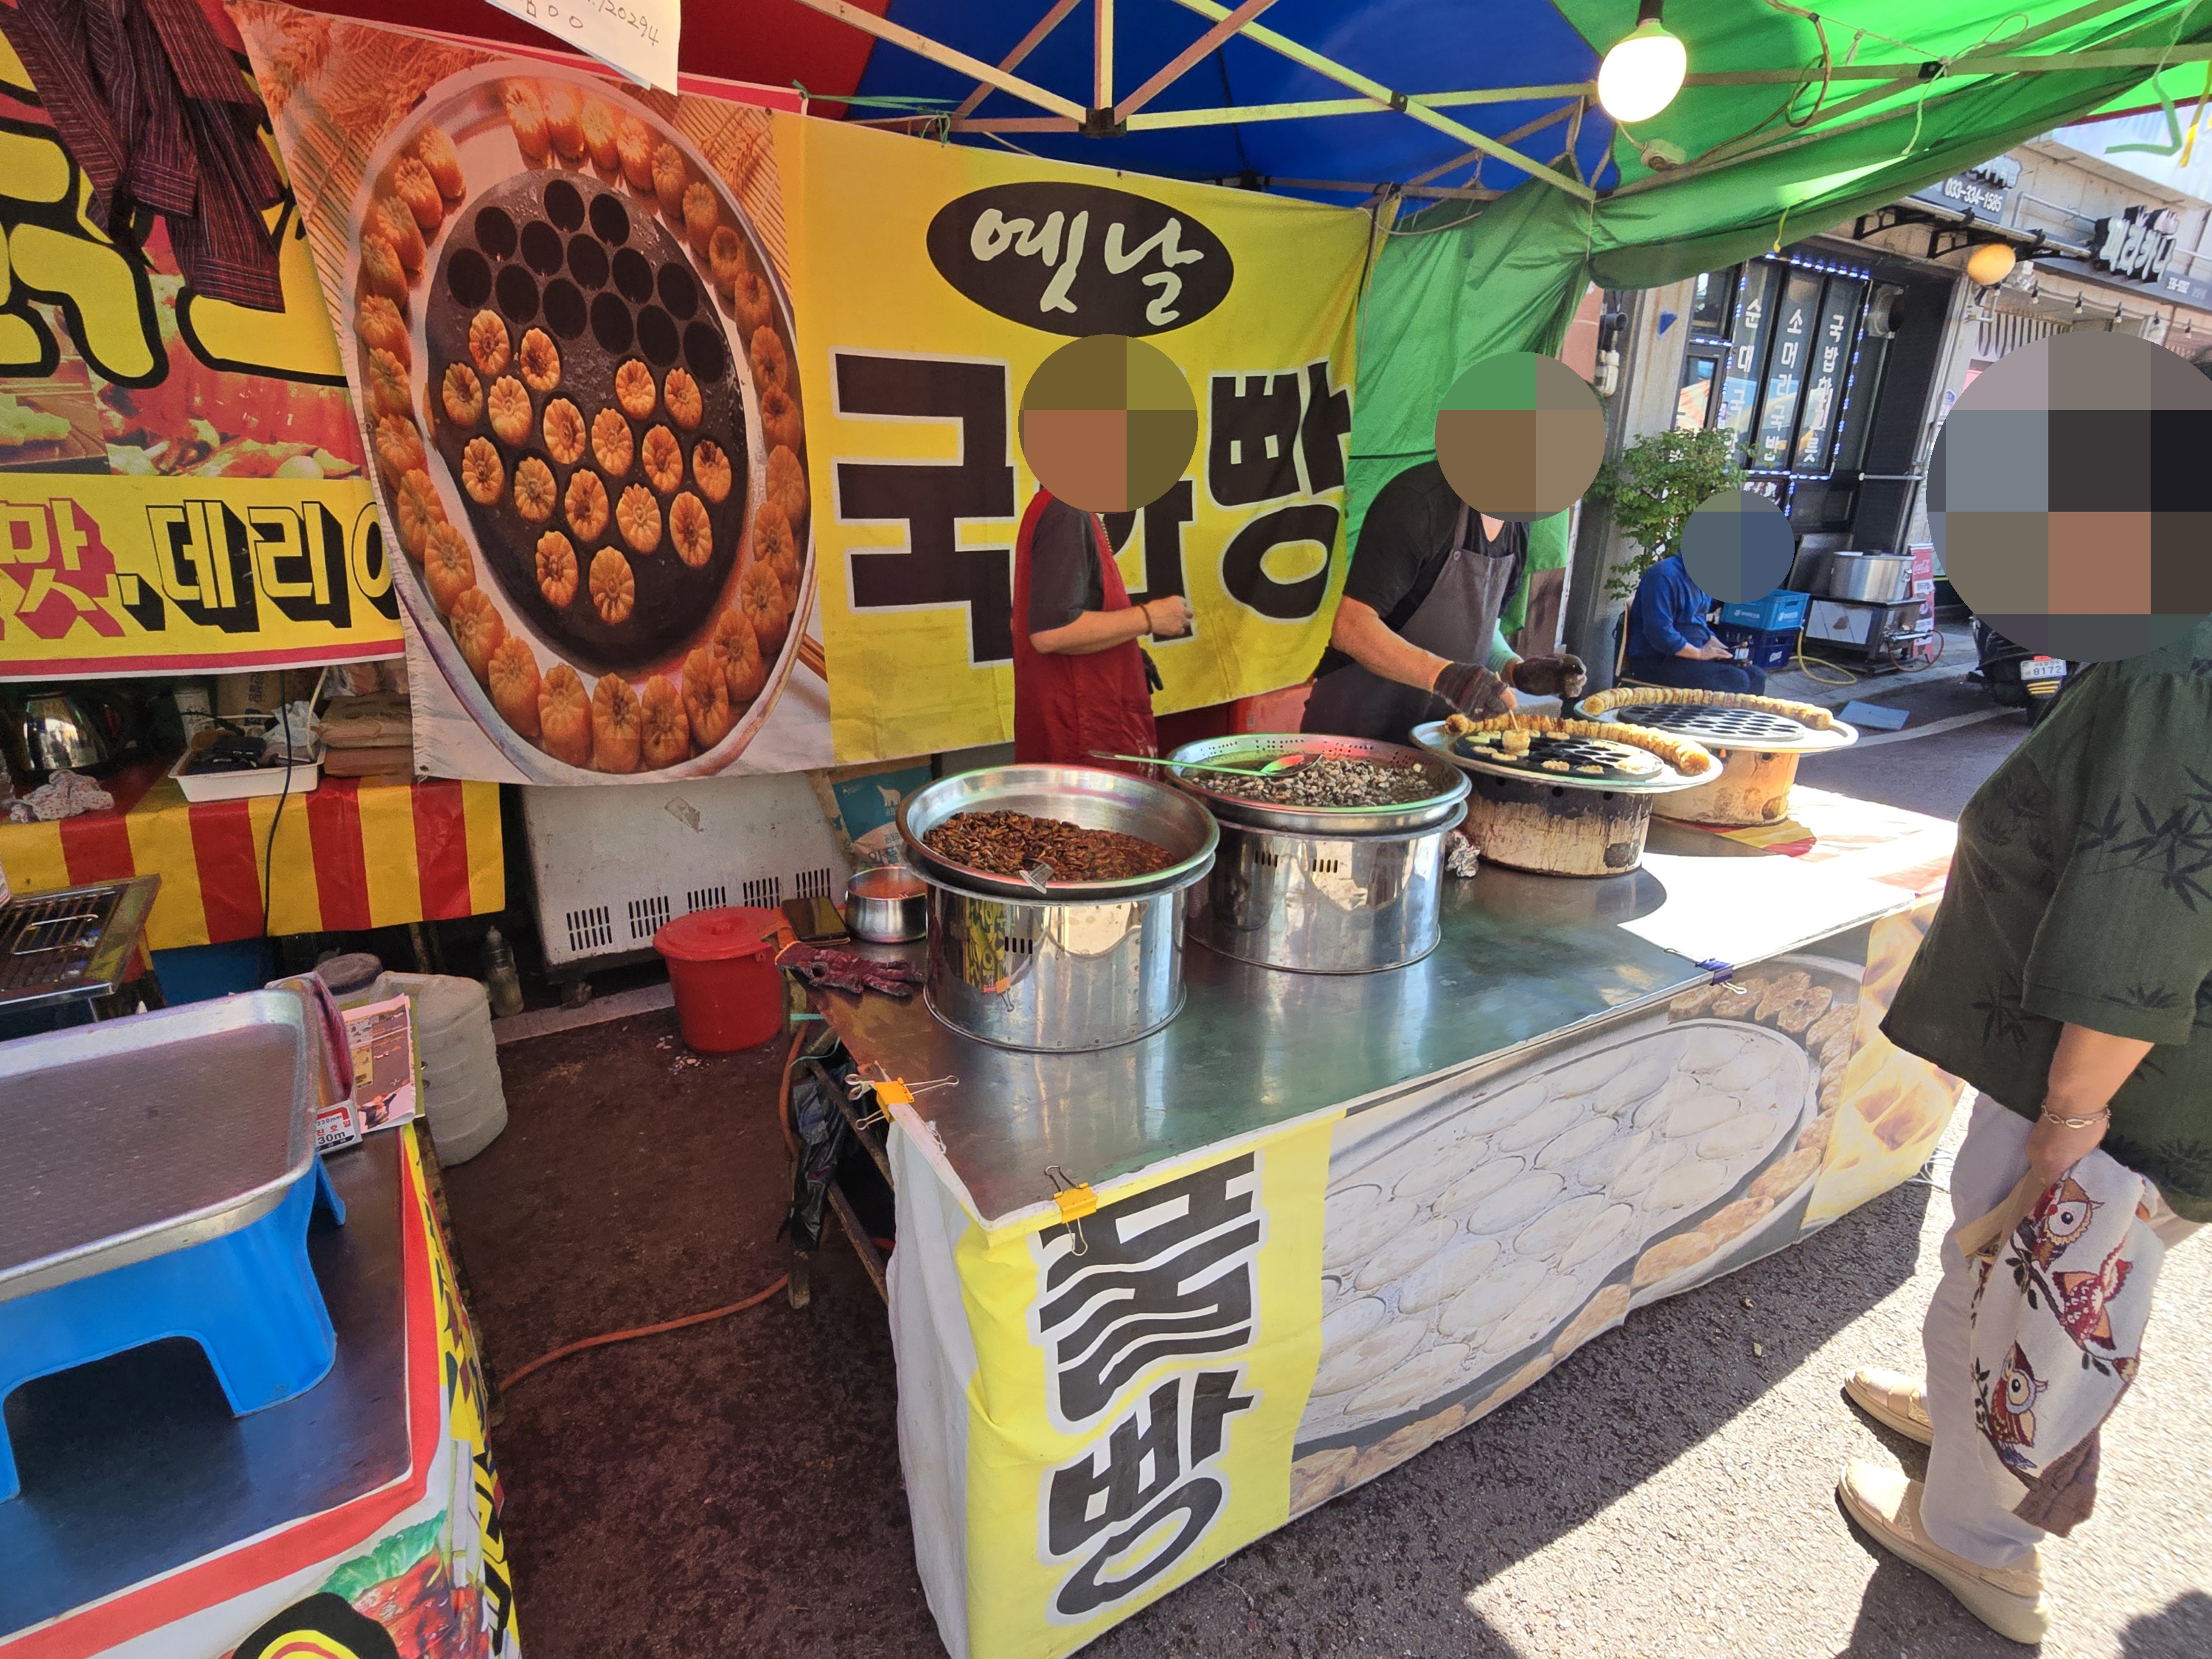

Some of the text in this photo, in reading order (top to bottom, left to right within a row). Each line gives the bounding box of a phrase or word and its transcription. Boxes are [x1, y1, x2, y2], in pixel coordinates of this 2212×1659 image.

[970, 208, 1205, 327] 옛날
[832, 351, 1352, 664] 국빵
[2033, 665, 2062, 675] 8172
[318, 1131, 346, 1144] 30m
